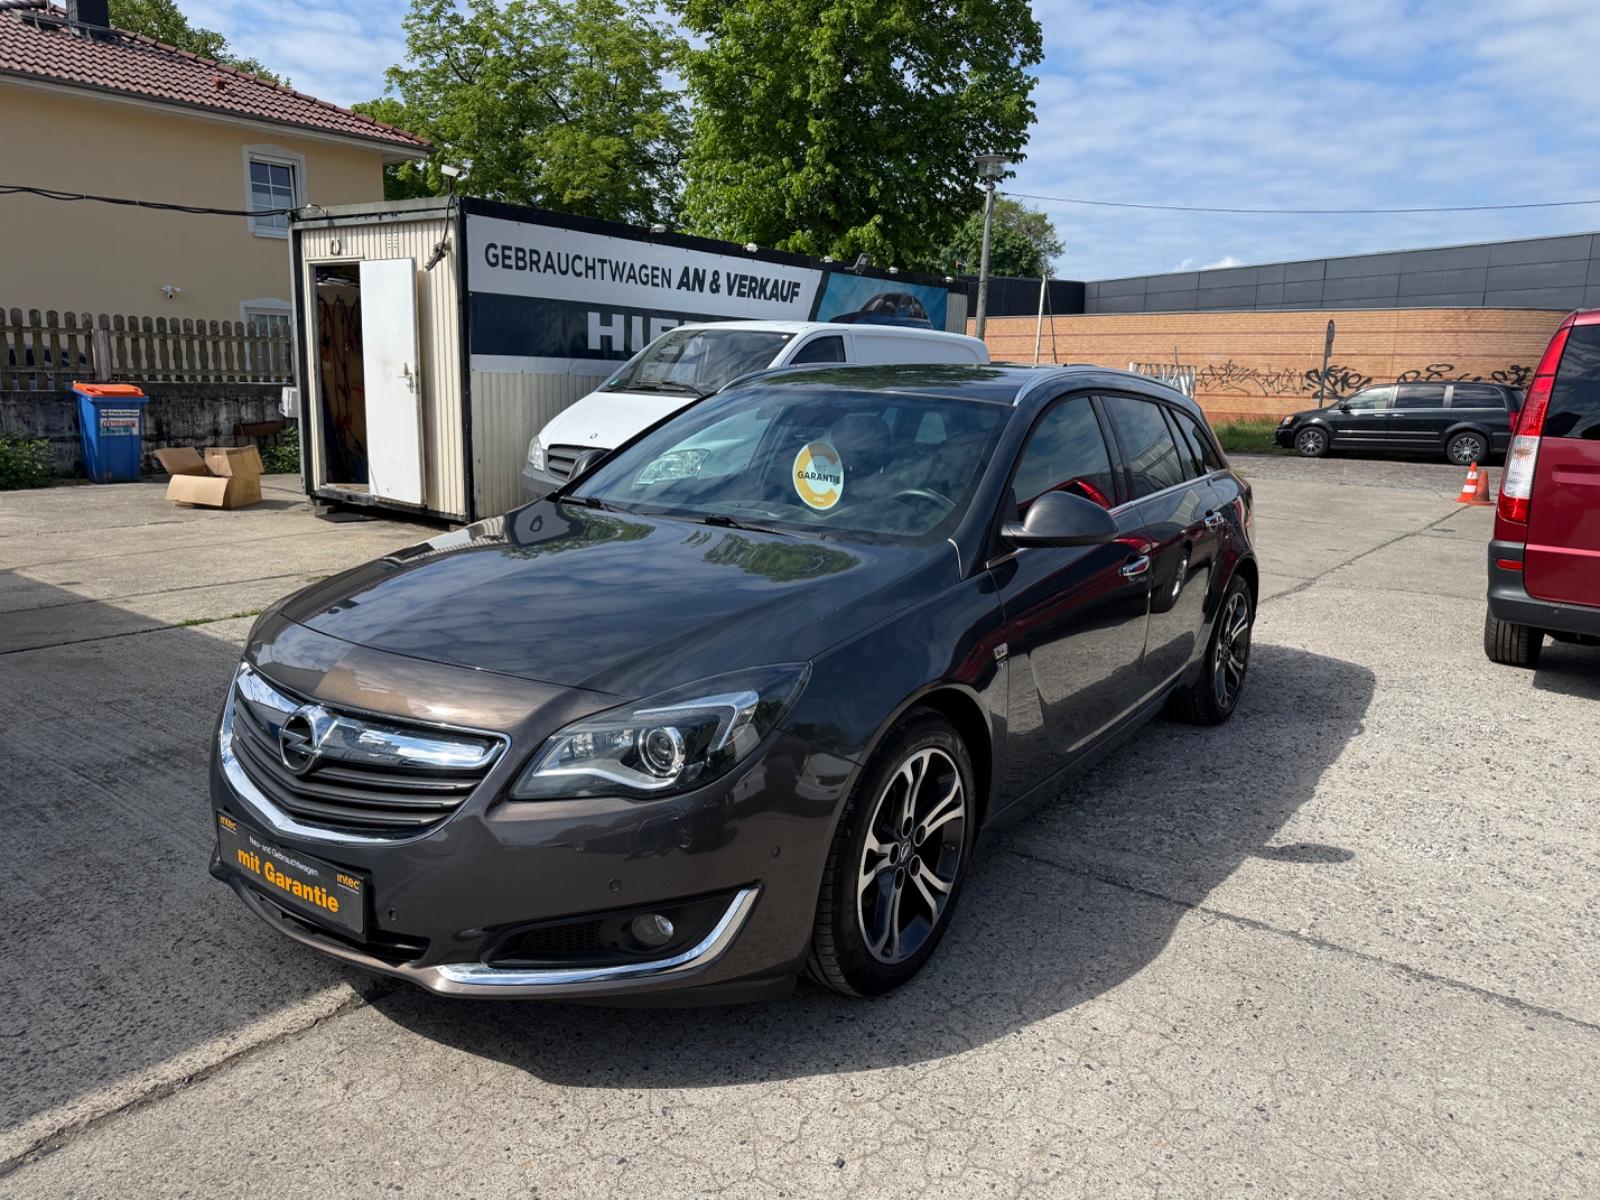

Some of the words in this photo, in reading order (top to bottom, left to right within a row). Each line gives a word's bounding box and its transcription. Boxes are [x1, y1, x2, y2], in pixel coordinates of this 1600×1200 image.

[484, 242, 672, 289] GEBRAUCHTWAGEN
[676, 266, 706, 293] AN
[709, 269, 721, 295] &
[726, 272, 801, 304] VERKAUF
[797, 470, 840, 485] GARANTIE
[237, 848, 261, 875] mit
[264, 861, 340, 913] Garantie
[336, 873, 361, 890] intec
